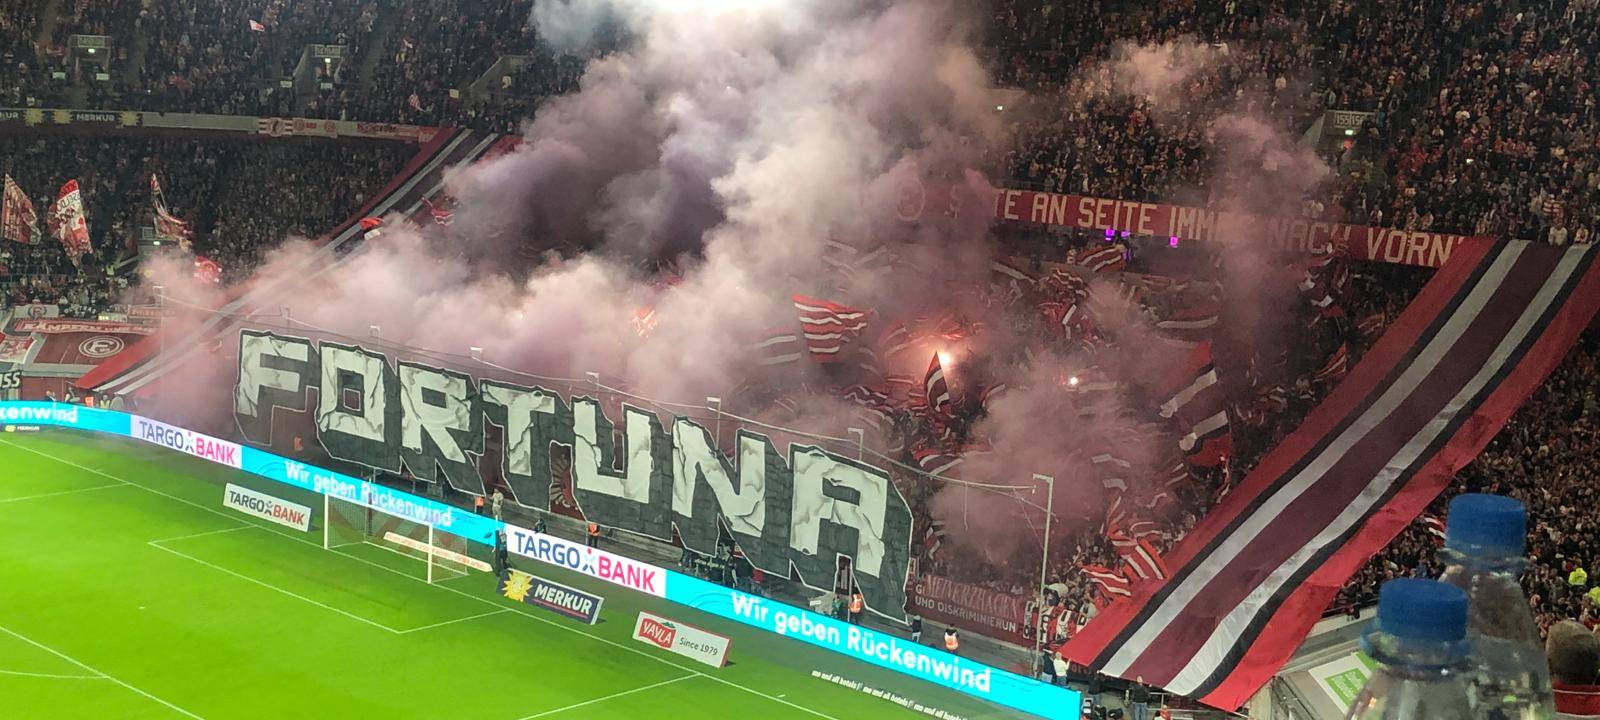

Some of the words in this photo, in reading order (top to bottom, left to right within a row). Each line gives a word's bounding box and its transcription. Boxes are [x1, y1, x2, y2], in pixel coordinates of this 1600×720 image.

[76, 113, 116, 121] MERKUR
[1032, 193, 1067, 226] AN
[1077, 197, 1156, 235] SEITE
[237, 332, 905, 605] FORTUNA
[284, 460, 311, 483] Wir
[313, 473, 357, 498] geben
[360, 481, 455, 526] Rückenwind
[535, 584, 592, 614] MERKUR
[642, 619, 673, 645] YAYLA
[679, 637, 700, 651] Since
[700, 643, 719, 657] 1979
[731, 592, 768, 622] Wir
[774, 608, 841, 646] geben
[847, 625, 991, 694] Rückenwind
